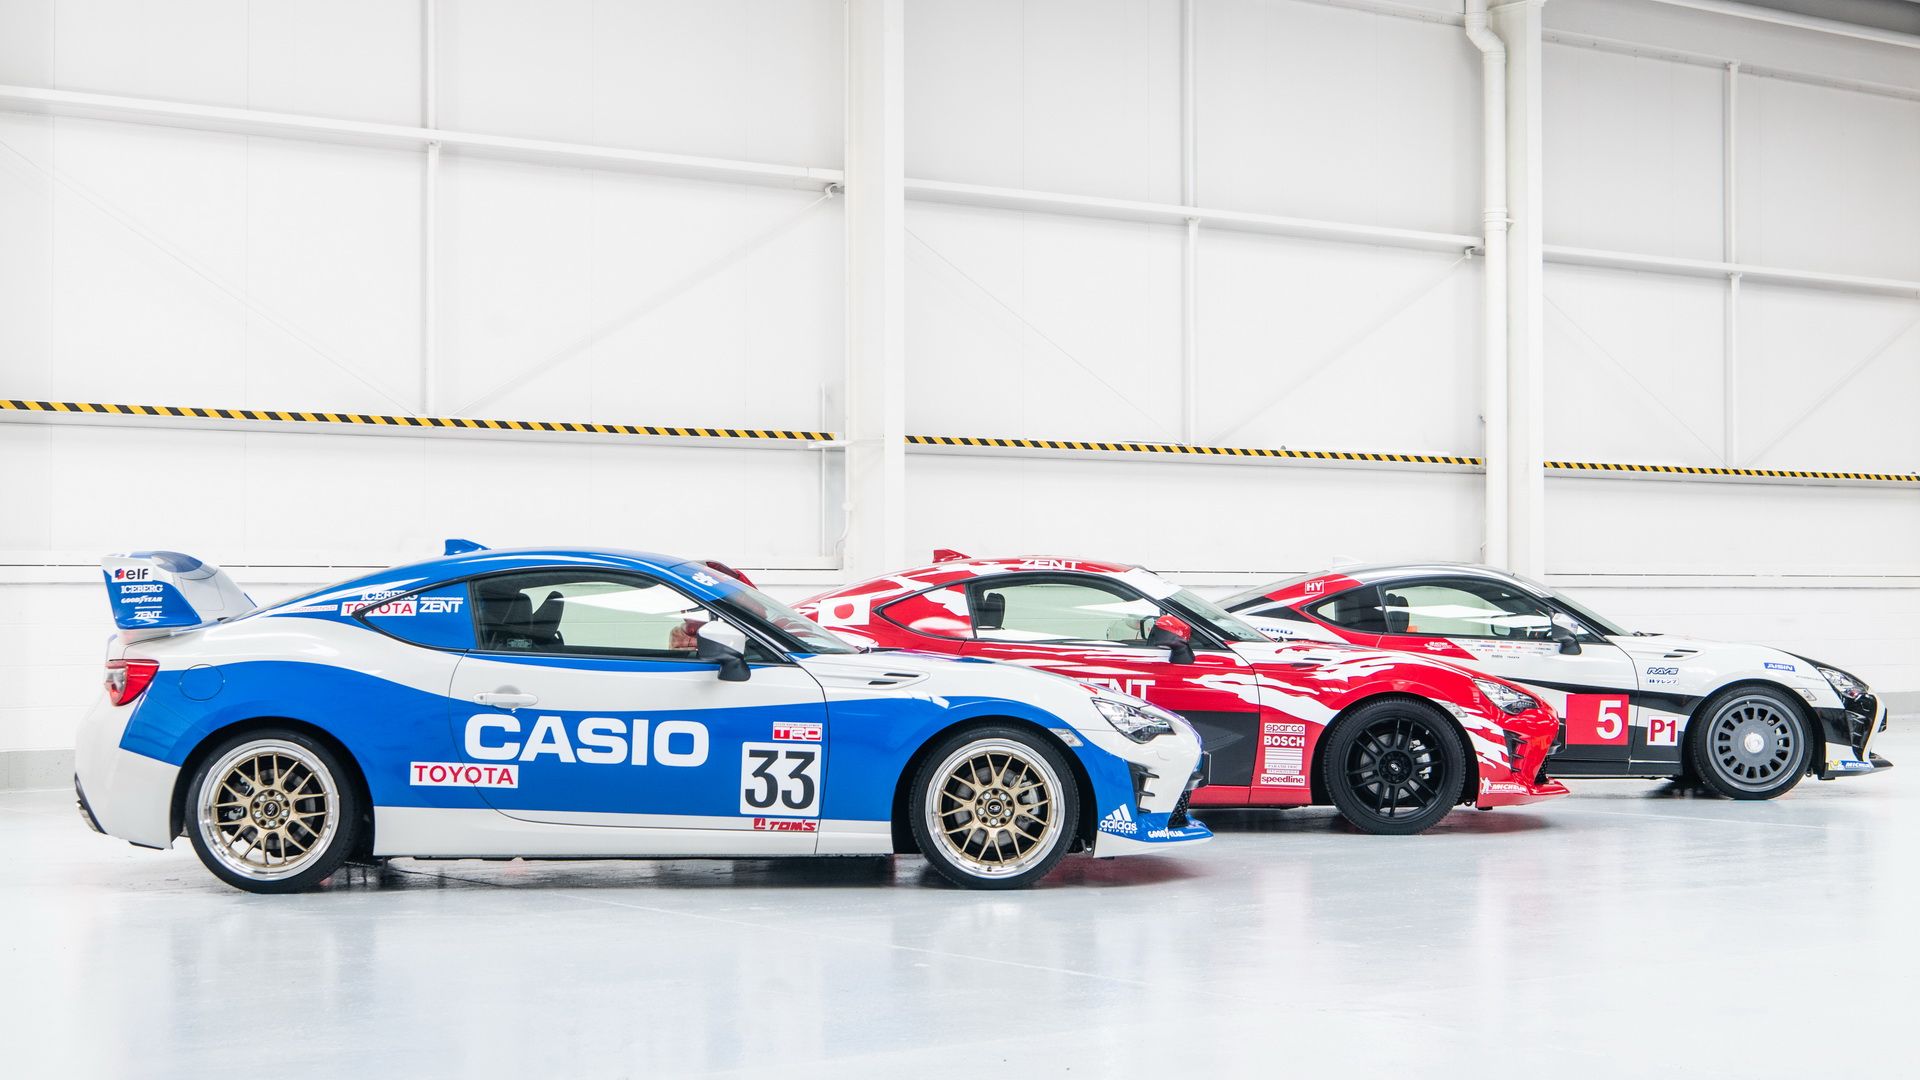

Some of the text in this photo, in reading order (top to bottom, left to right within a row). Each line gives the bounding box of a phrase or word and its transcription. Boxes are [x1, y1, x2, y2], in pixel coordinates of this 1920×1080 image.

[1019, 559, 1081, 570] ZENT
[126, 568, 149, 580] elf
[121, 584, 163, 593] ICEBERG
[1306, 582, 1322, 591] HY
[420, 601, 463, 613] ZENT
[134, 610, 162, 619] ZENT
[1647, 667, 1679, 675] RAYS
[1768, 663, 1793, 671] AISIN
[1596, 700, 1623, 740] 5
[1265, 724, 1304, 734] sparco
[1650, 719, 1676, 742] P1
[464, 713, 710, 767] CASIO
[1263, 735, 1305, 747] BOSCH
[414, 765, 514, 785] TOYOTA
[745, 749, 816, 810] 33
[1261, 776, 1304, 784] speedline
[769, 819, 817, 832] TOM'S
[1100, 820, 1137, 831] adidas
